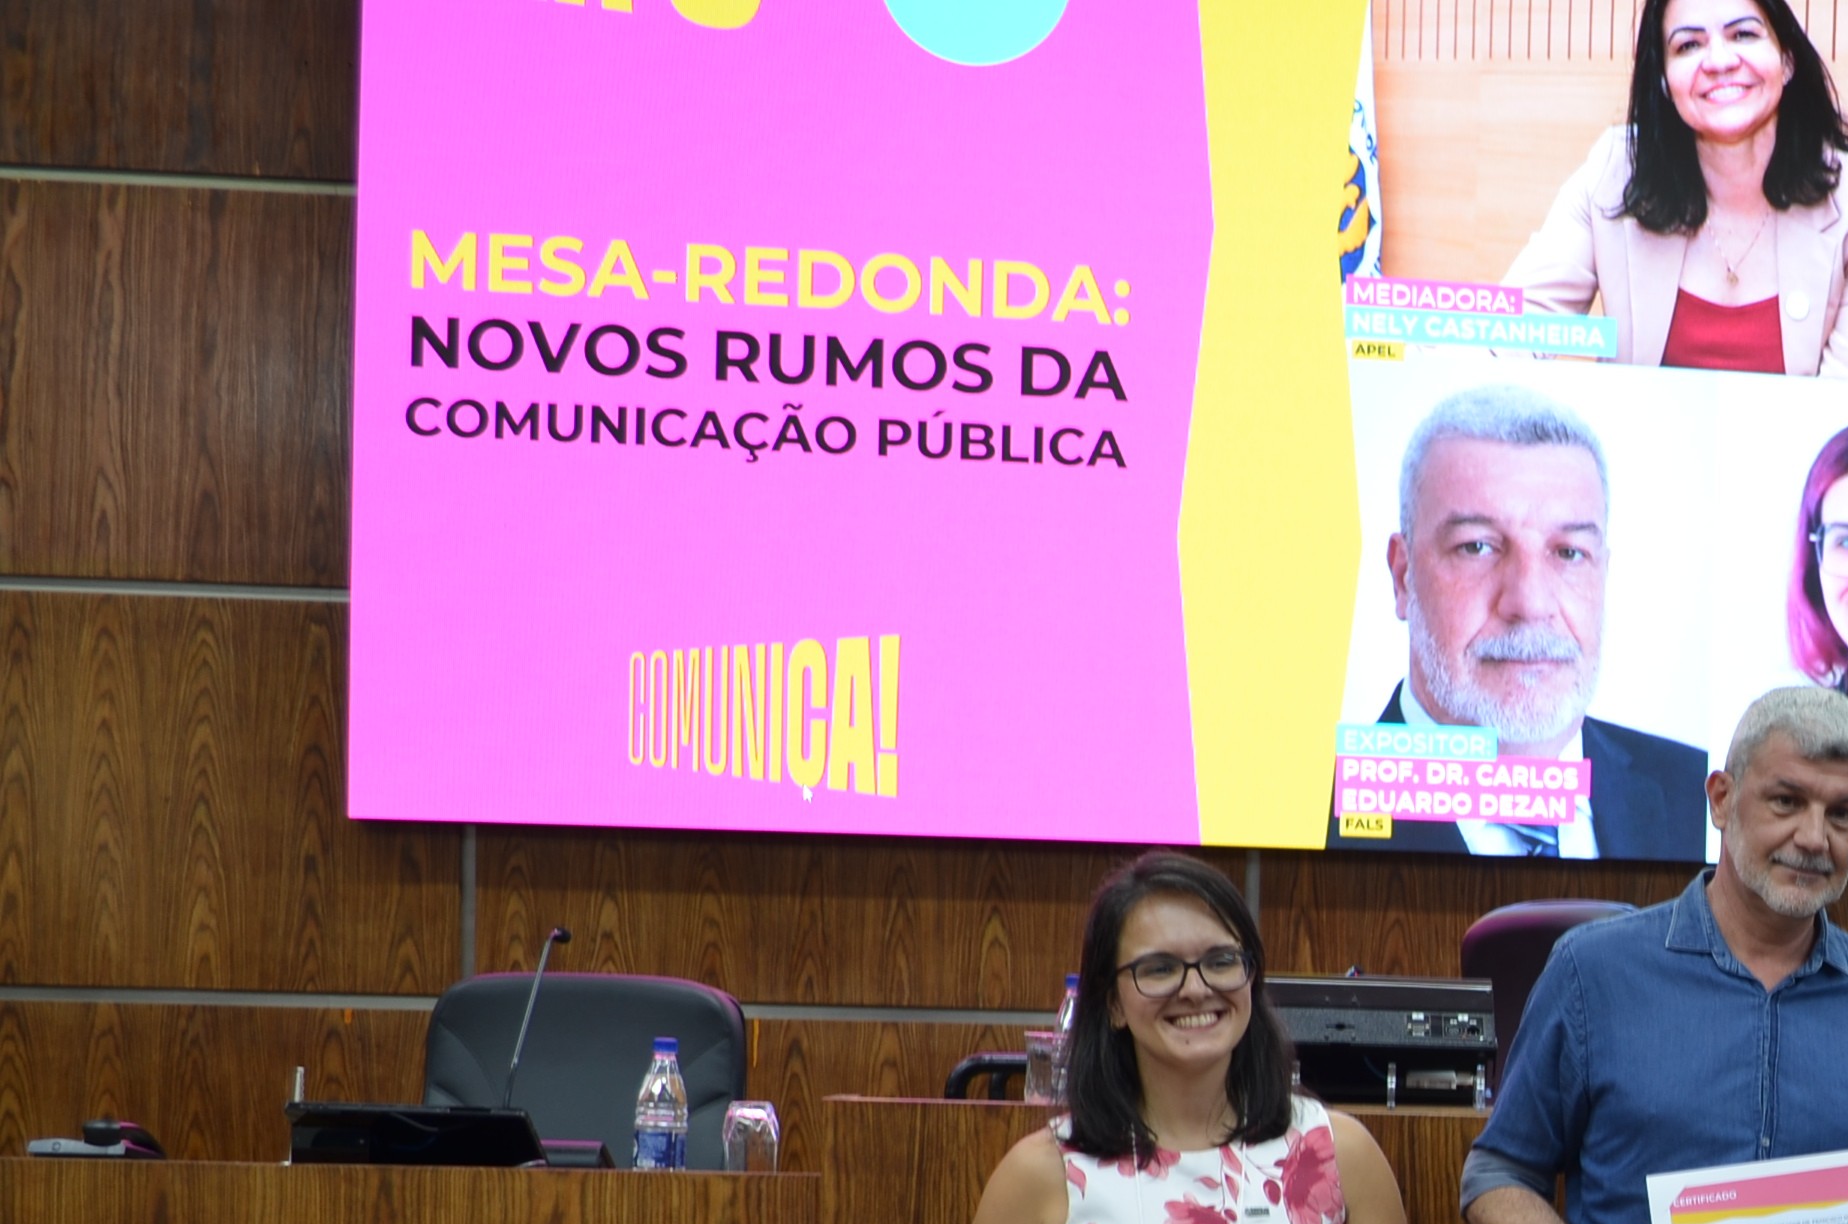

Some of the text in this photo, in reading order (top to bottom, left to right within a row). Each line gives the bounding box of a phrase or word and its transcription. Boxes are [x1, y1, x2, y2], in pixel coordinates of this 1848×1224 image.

[409, 230, 1131, 326] MESA-REDONDA:
[1353, 282, 1516, 313] MEDIADORA:
[1353, 313, 1605, 348] NELY CASTANHEIRA
[409, 315, 1128, 402] NOVOS RUMOS DA
[1355, 344, 1396, 357] APEL
[404, 397, 1128, 468] COMUNICAÇÃO PÚBLICA
[1344, 729, 1492, 756] EXPOSITOR:
[1343, 758, 1579, 790] PROF. DR. CARLOS
[1342, 788, 1566, 820] EDUARDO DEZAN
[1345, 817, 1384, 831] FALS
